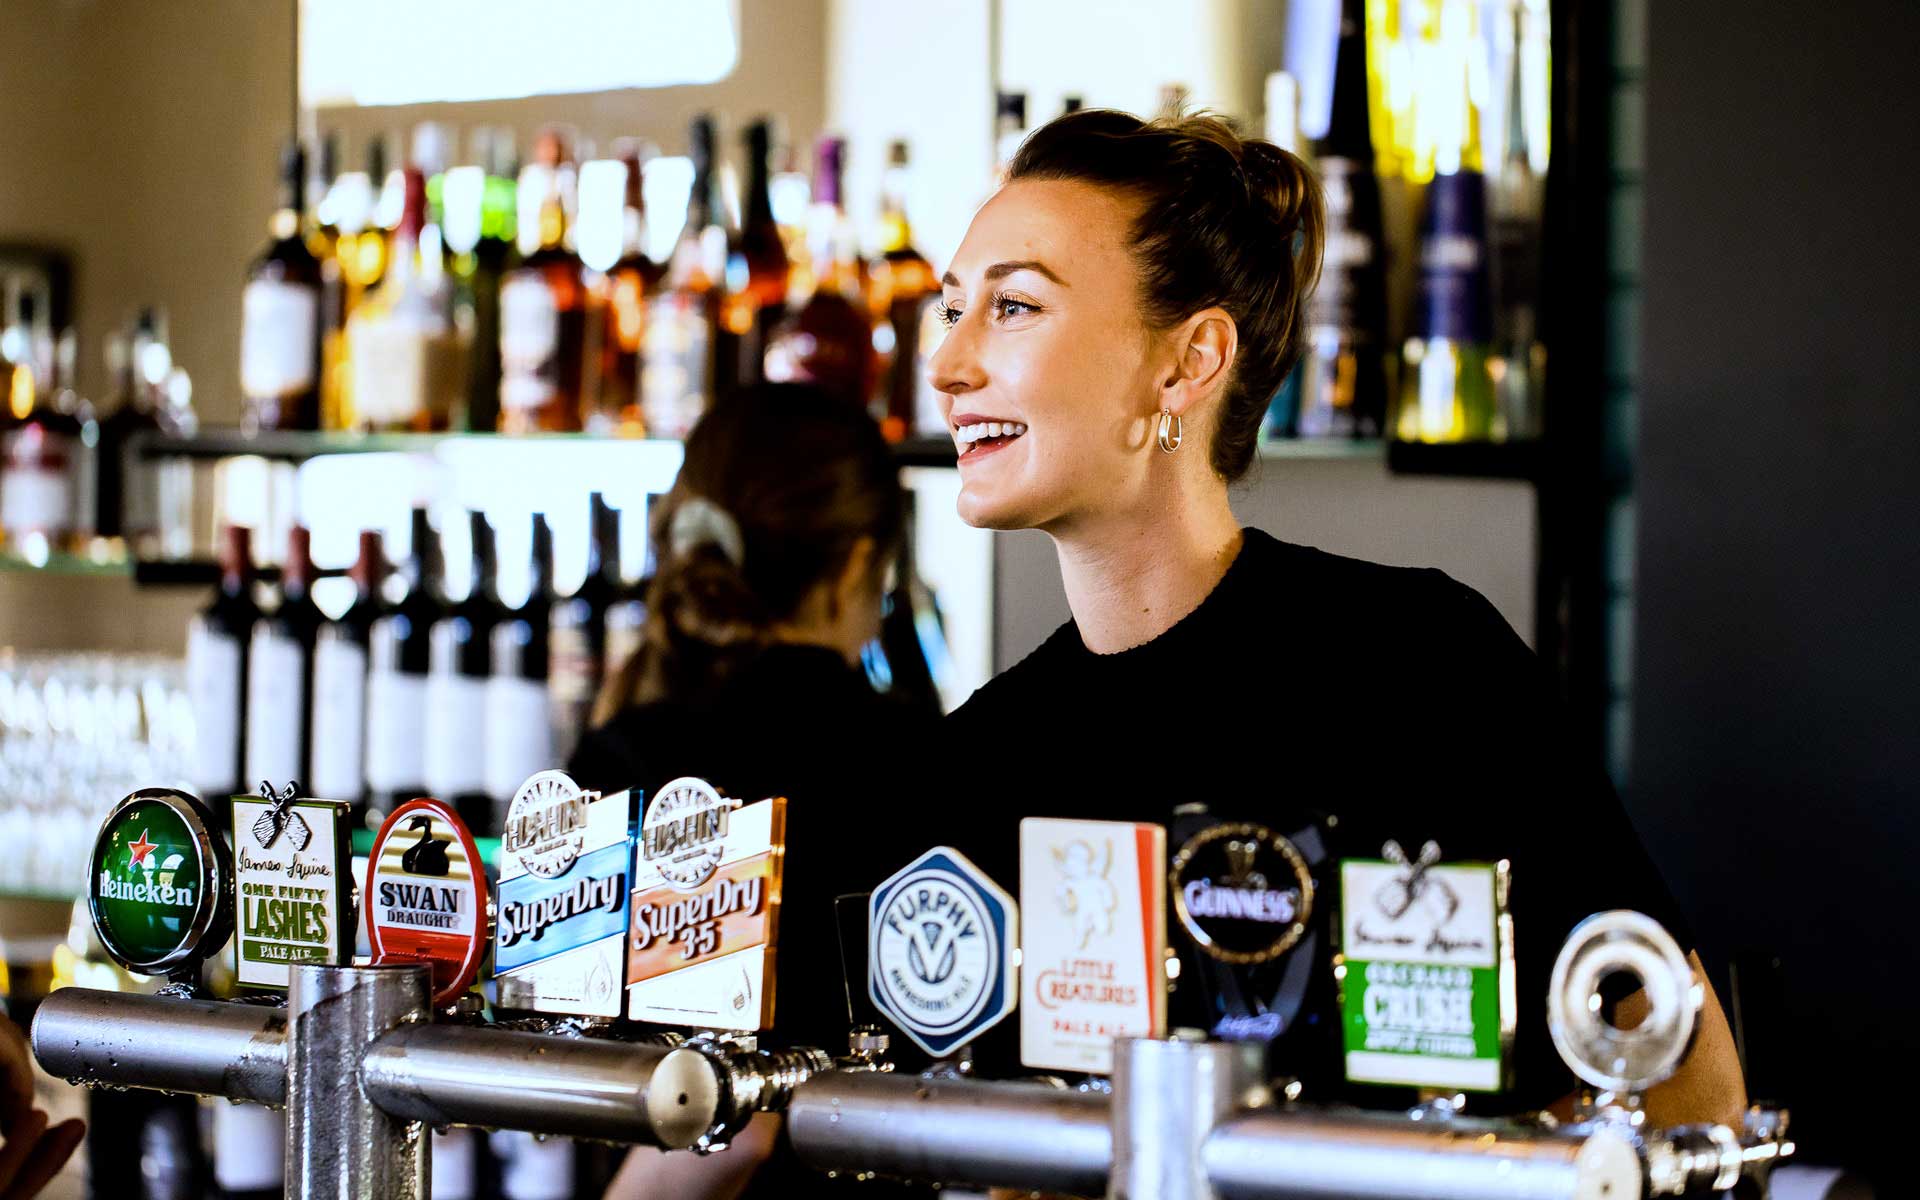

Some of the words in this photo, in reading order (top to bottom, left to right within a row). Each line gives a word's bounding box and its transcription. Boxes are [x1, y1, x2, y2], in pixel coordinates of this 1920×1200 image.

[505, 797, 587, 852] HAHN
[643, 804, 729, 860] HAHN
[238, 846, 281, 873] James
[286, 853, 330, 880] Squire
[100, 871, 194, 906] Heineken
[242, 883, 274, 897] ONE
[279, 886, 326, 900] FIFTY
[380, 882, 460, 913] SWAN
[498, 873, 620, 947] SuperDry
[1184, 880, 1295, 923] GUINNESS
[243, 897, 328, 944] LASHES
[387, 909, 454, 928] DRAUGHT
[633, 876, 762, 950] SuperDry
[888, 890, 976, 938] FURPHY
[260, 945, 287, 960] PALE
[289, 949, 312, 960] ALE
